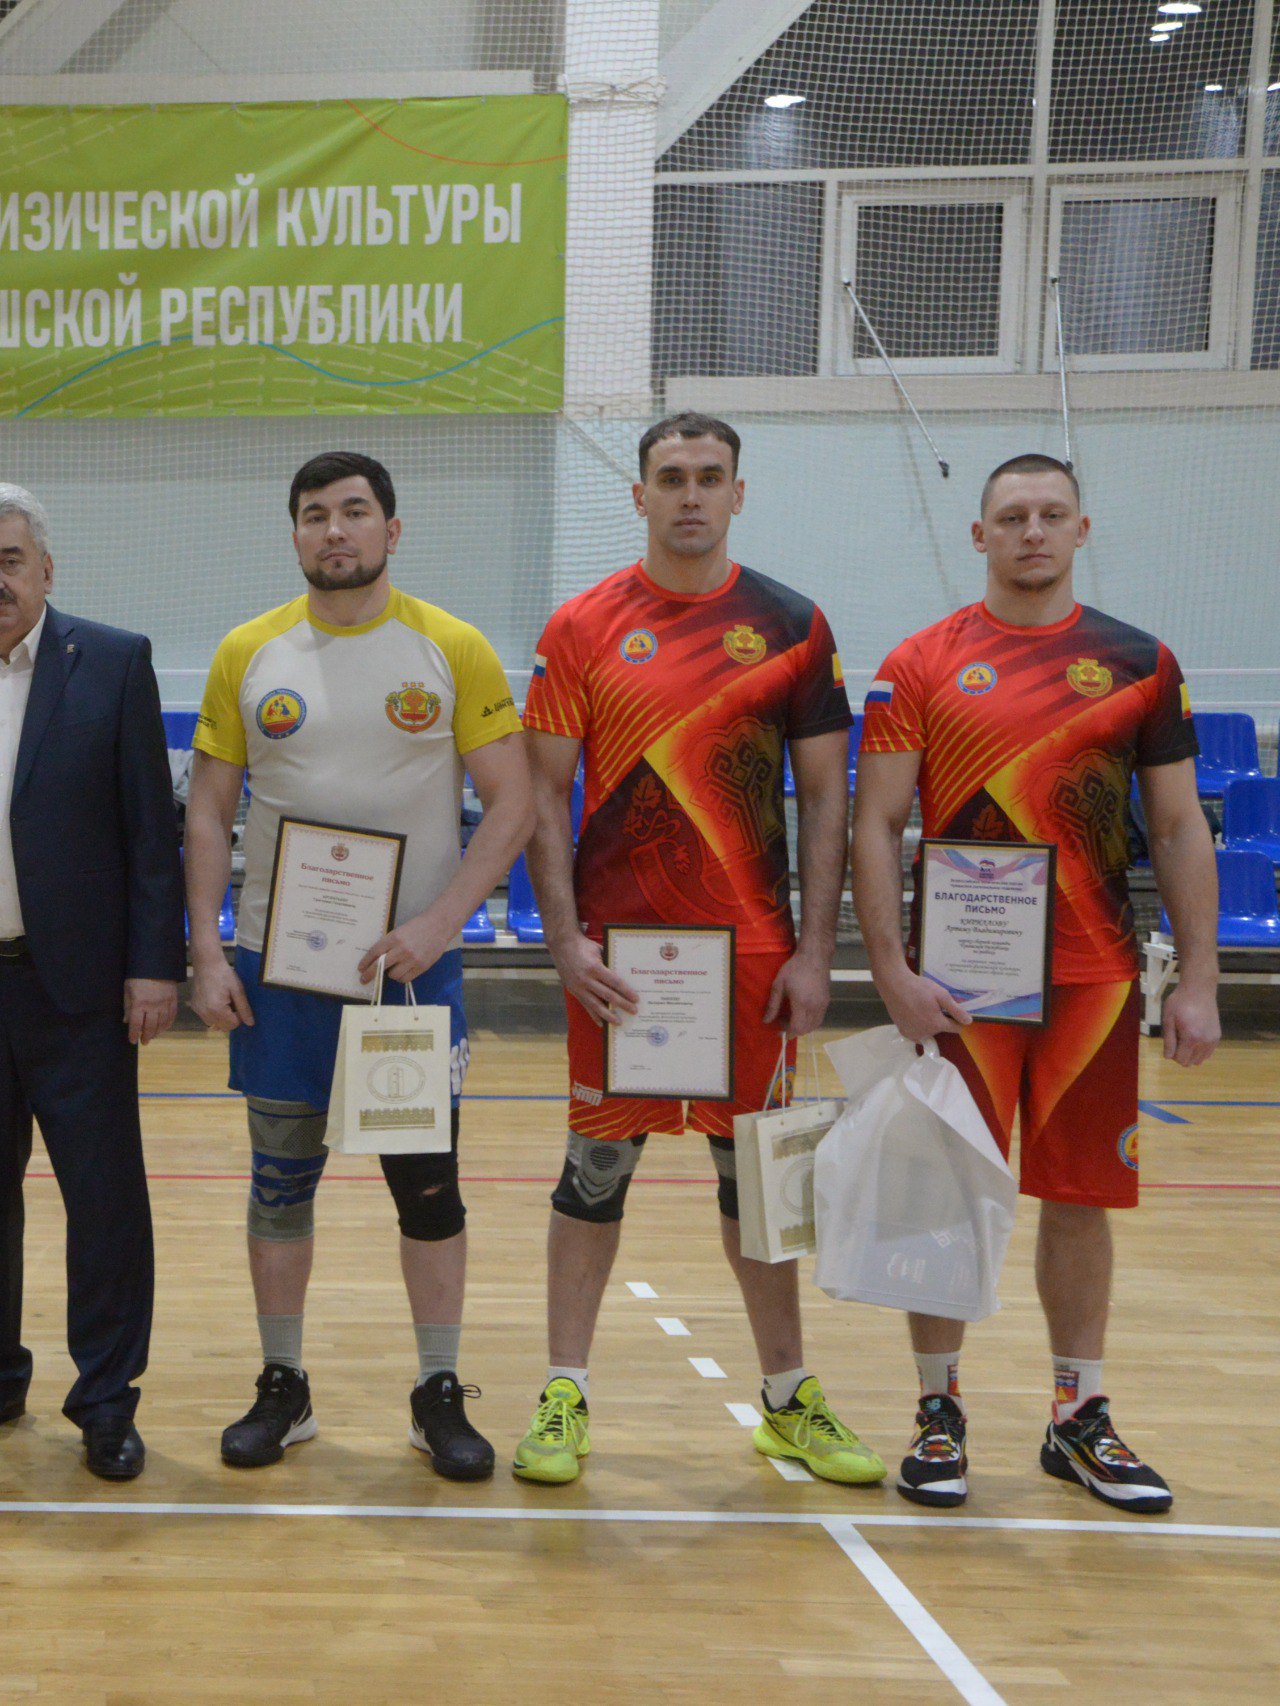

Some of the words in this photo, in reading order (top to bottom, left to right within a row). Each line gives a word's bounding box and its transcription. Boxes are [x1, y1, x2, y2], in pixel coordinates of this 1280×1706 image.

[277, 183, 522, 247] КУЛЬТУРЫ
[159, 283, 463, 347] РЕСПУБЛИКИ
[301, 862, 375, 881] Благодарственное
[321, 876, 351, 887] письмо
[934, 892, 1038, 905] БЛАГОДАРСТВЕННОЕ
[965, 905, 1006, 915] ПИСЬМО
[631, 967, 708, 977] Благодарственное
